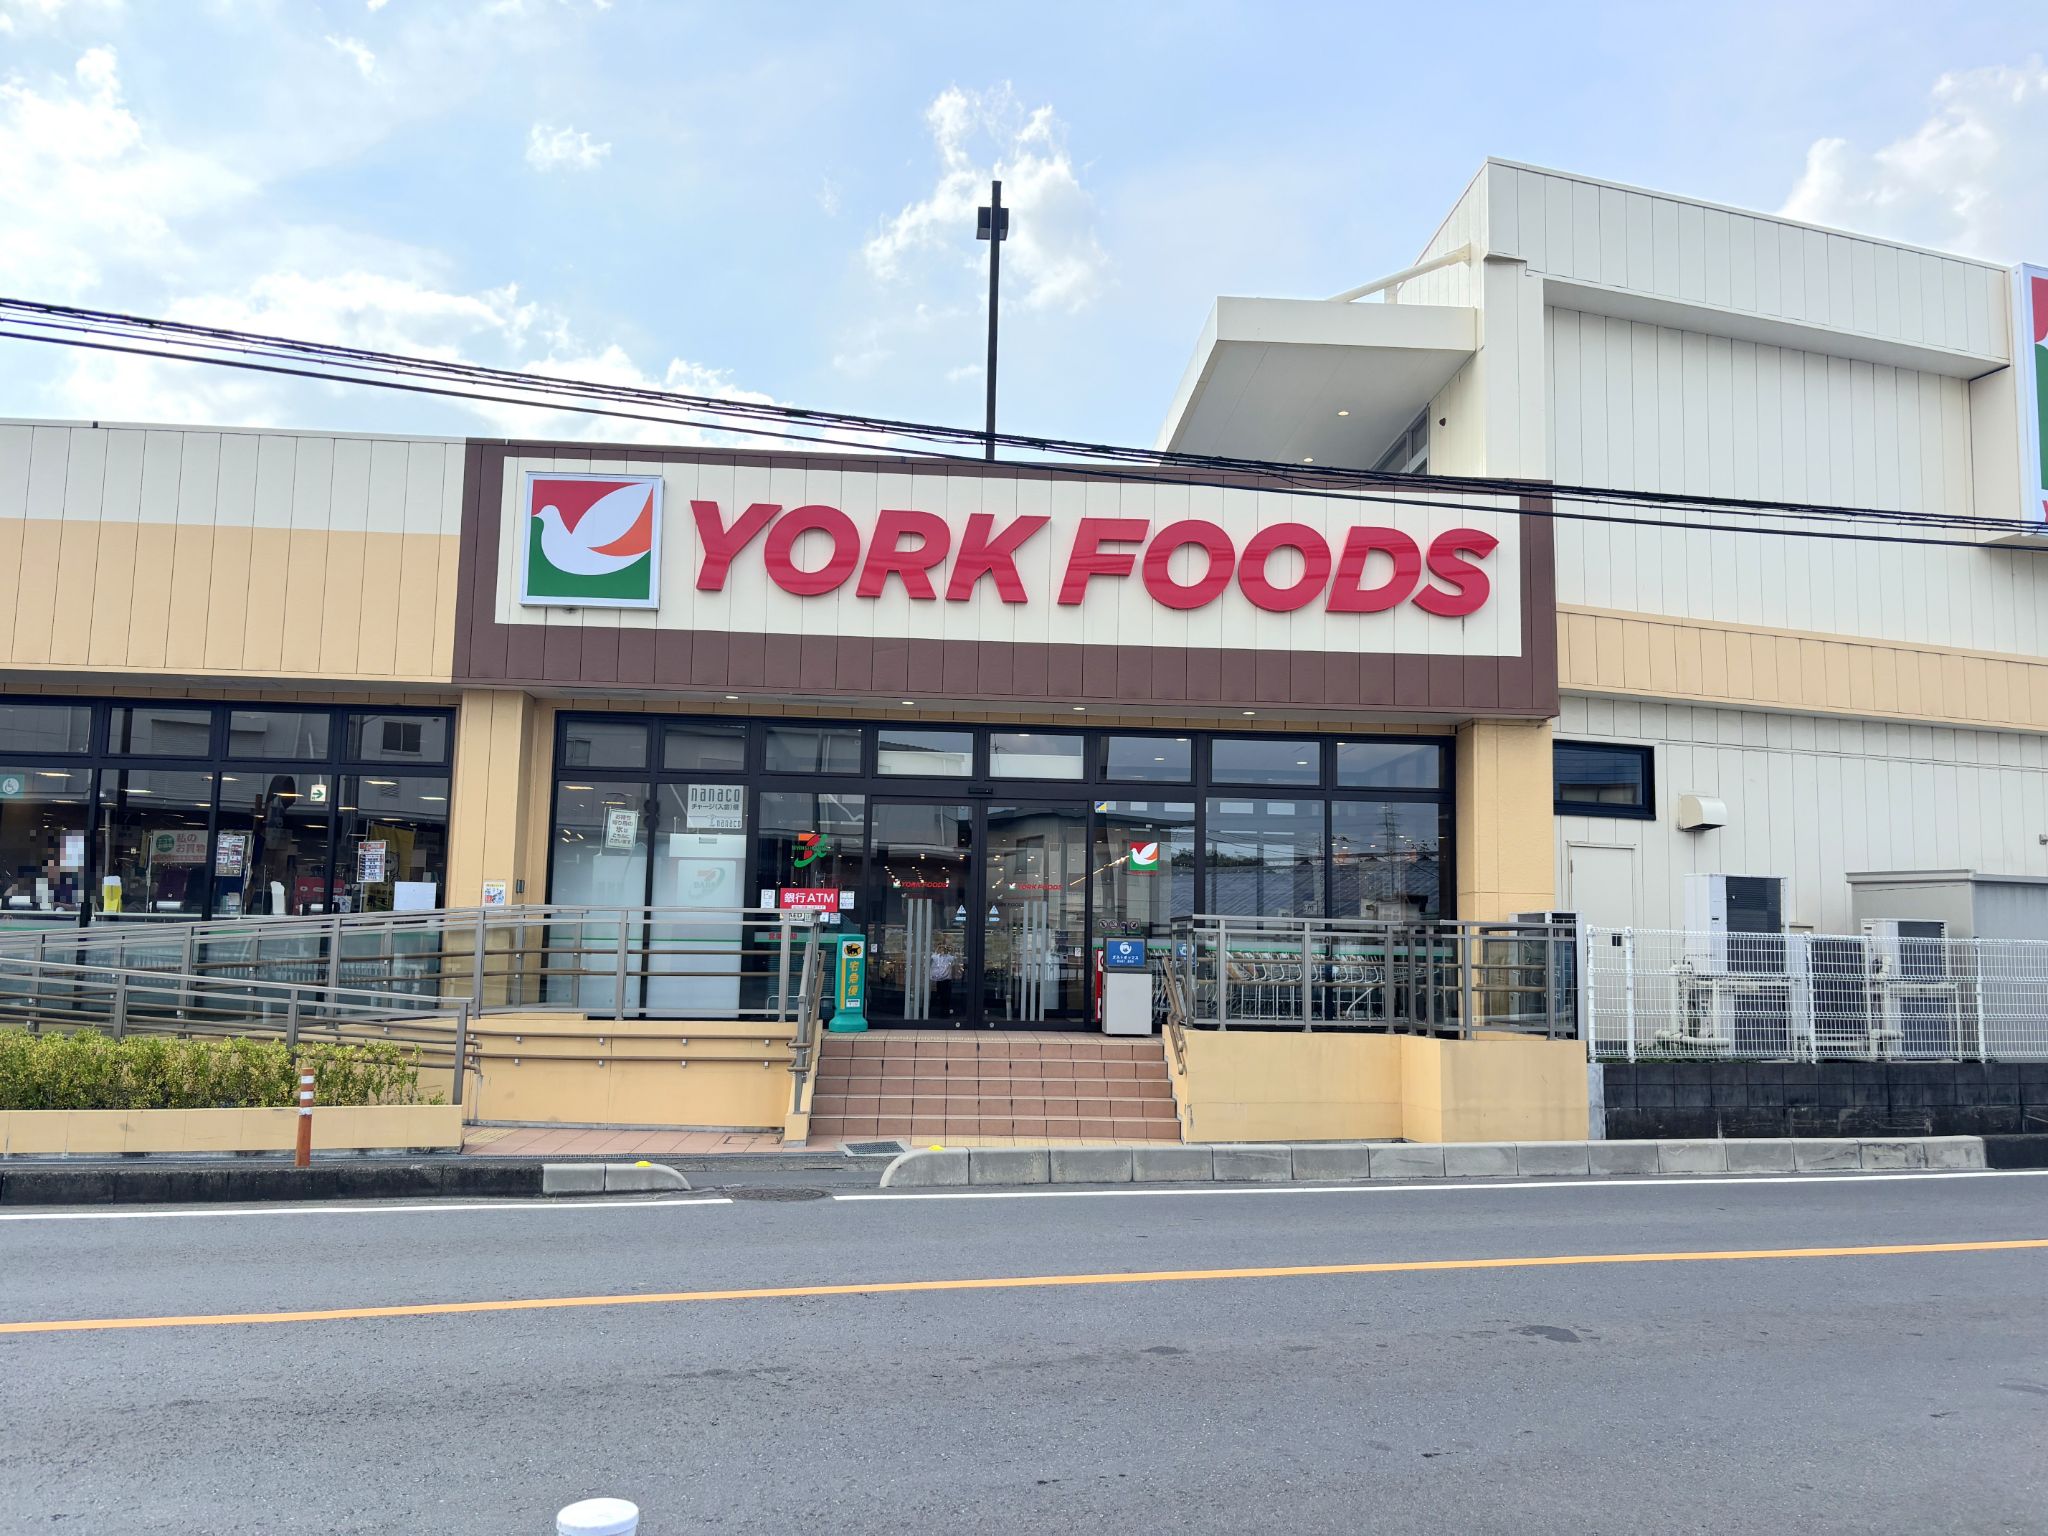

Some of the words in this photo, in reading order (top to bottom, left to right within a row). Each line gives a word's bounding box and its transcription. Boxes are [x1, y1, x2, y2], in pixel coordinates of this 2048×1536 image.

[689, 500, 1051, 604] YORK
[1058, 516, 1501, 618] FOODS
[690, 787, 740, 802] nanaco
[716, 819, 741, 828] nanaco
[784, 892, 834, 903] 銀行ATM
[848, 961, 860, 996] 宅急便
